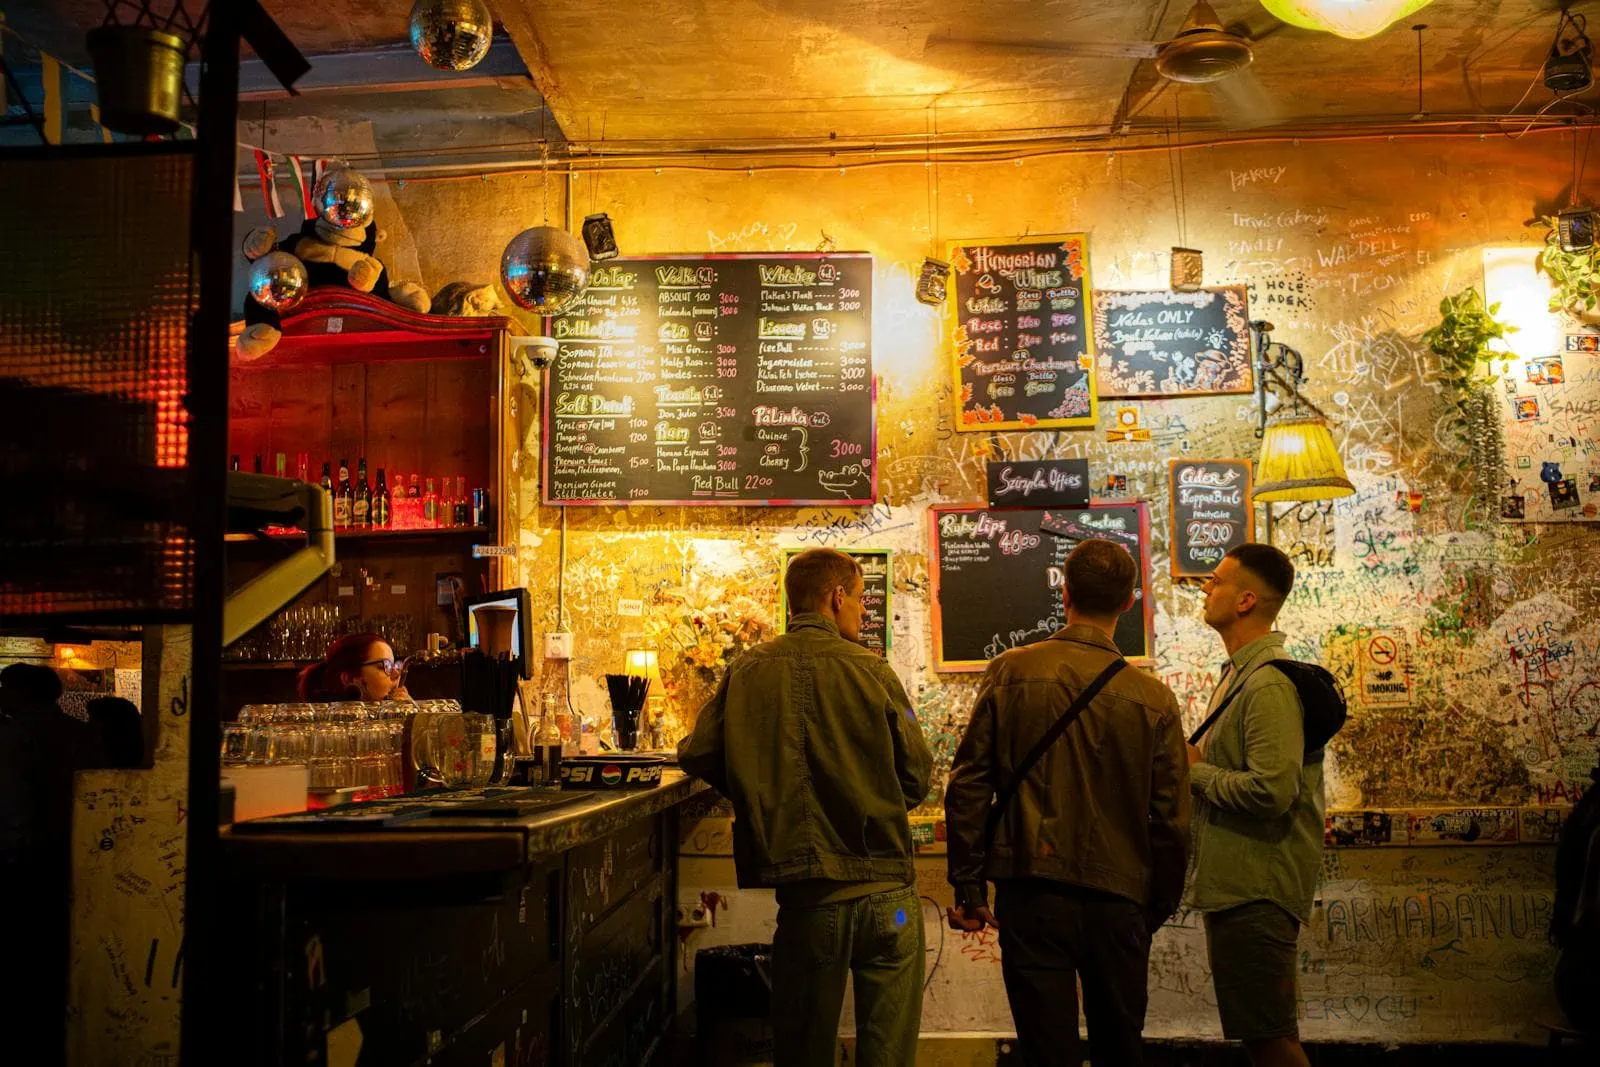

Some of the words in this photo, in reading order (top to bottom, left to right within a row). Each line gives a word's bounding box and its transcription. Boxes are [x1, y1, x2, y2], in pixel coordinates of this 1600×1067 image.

[1157, 310, 1194, 325] ONLY
[830, 440, 862, 458] 3000
[692, 474, 712, 491] Red
[714, 476, 739, 491] Bull
[745, 475, 773, 489] 2200
[999, 529, 1040, 555] 4800
[1187, 522, 1232, 546] 2500
[1367, 683, 1407, 693] SMOKING
